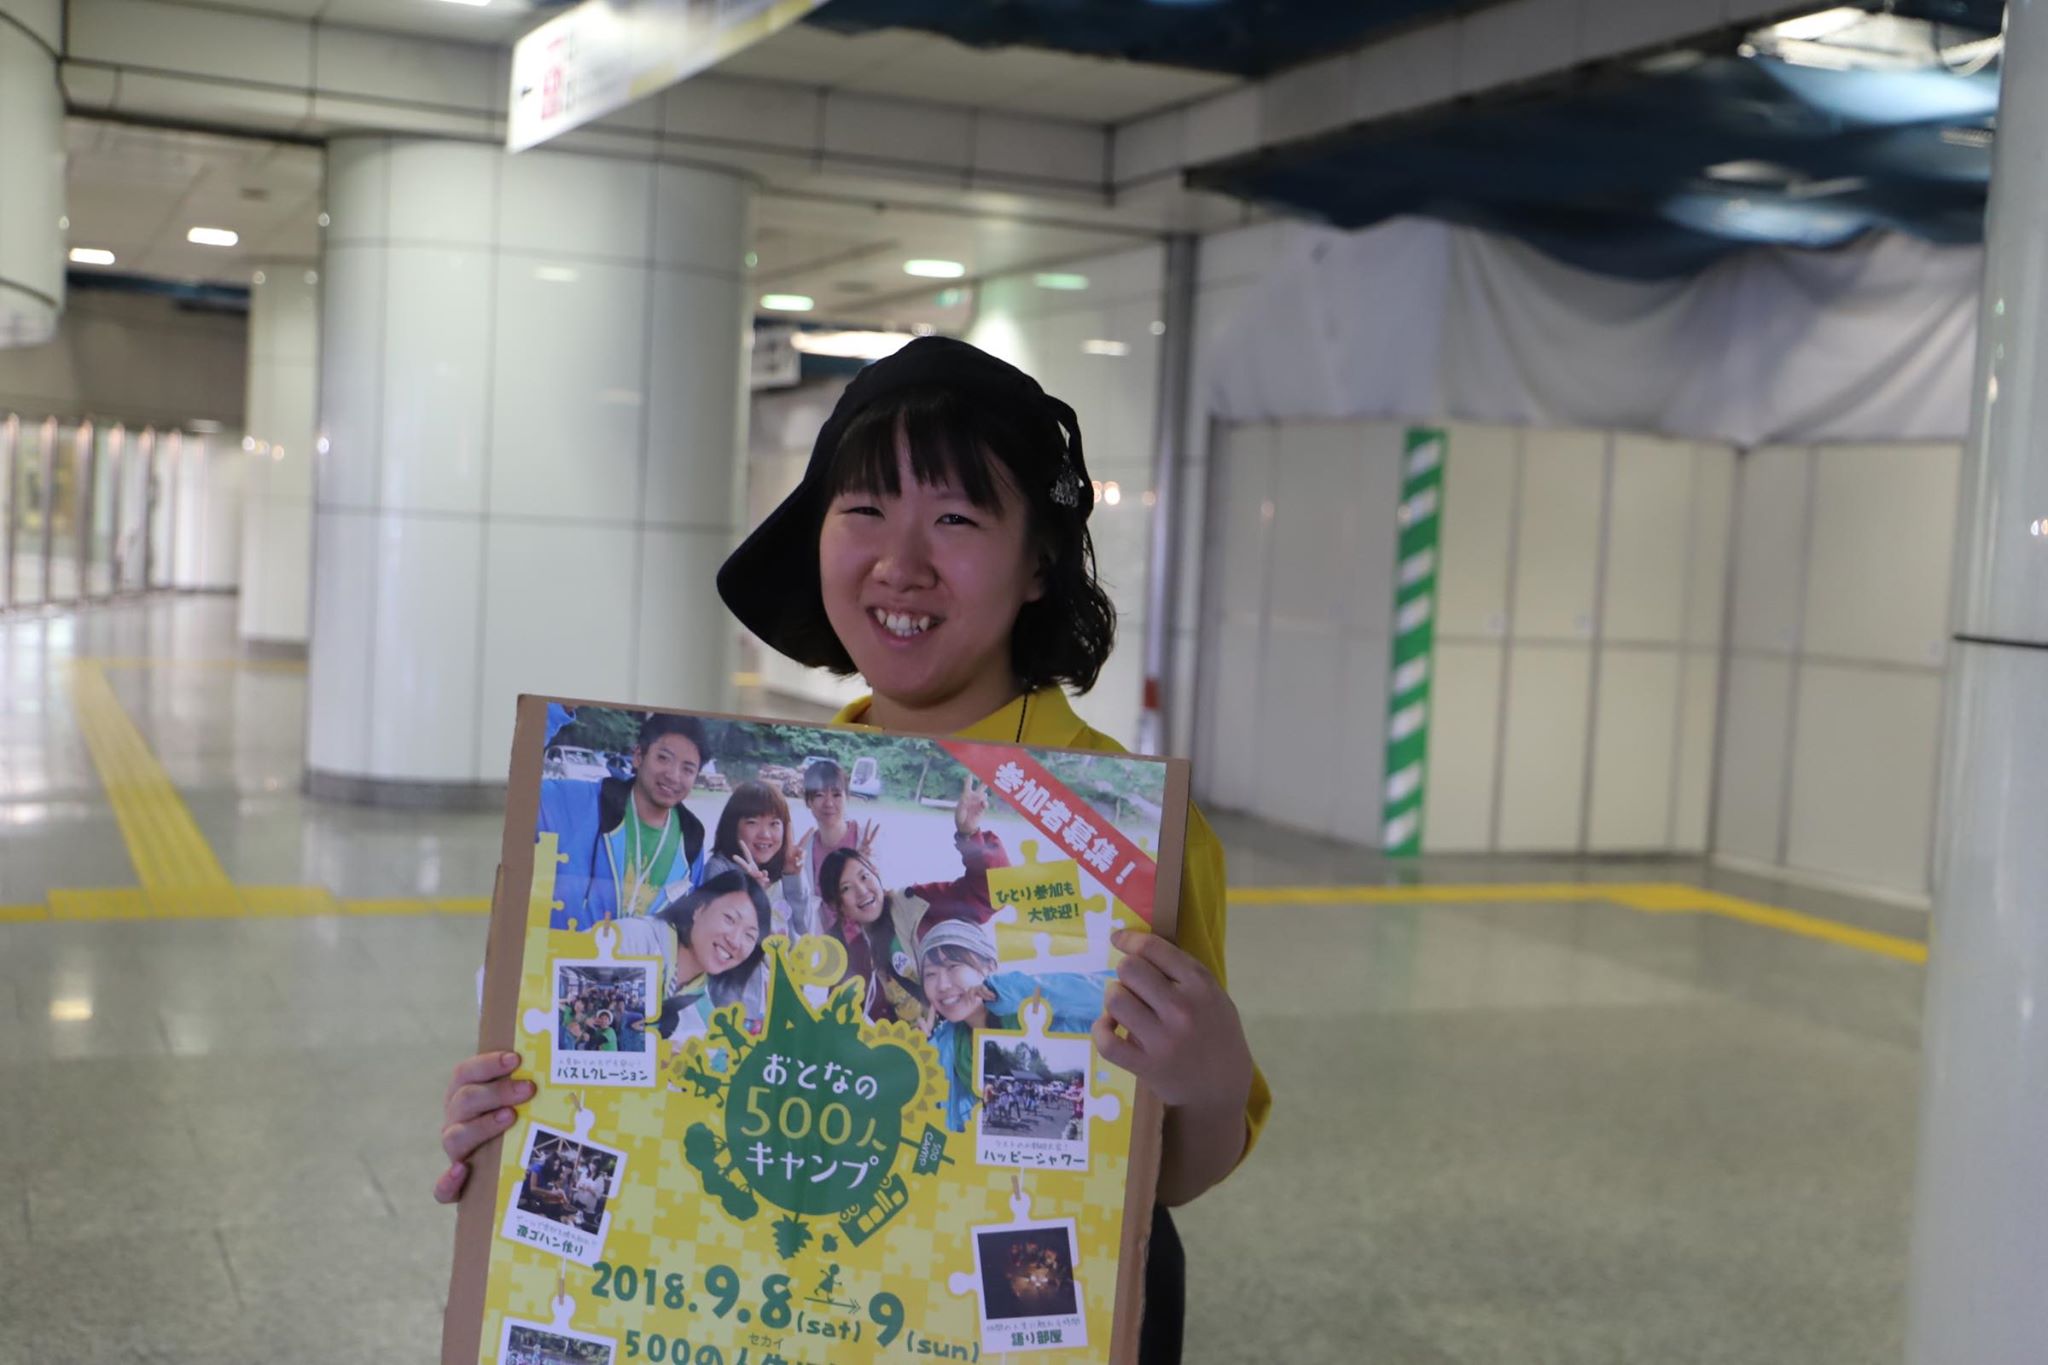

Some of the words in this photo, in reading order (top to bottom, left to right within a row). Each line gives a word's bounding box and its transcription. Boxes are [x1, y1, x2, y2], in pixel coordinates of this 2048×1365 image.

[996, 881, 1075, 904] ひとり参加も
[1028, 903, 1080, 923] 大歓迎！
[557, 1067, 648, 1081] バスレクレーション
[762, 1054, 878, 1100] おとなの
[740, 1086, 887, 1151] 500人
[745, 1141, 880, 1189] キャンプ
[984, 1150, 1086, 1166] ハッピーシャワー
[516, 1224, 584, 1257] 夜ゴハン作り
[749, 1333, 784, 1350] セカイ
[1011, 1329, 1063, 1346] 語り部屋
